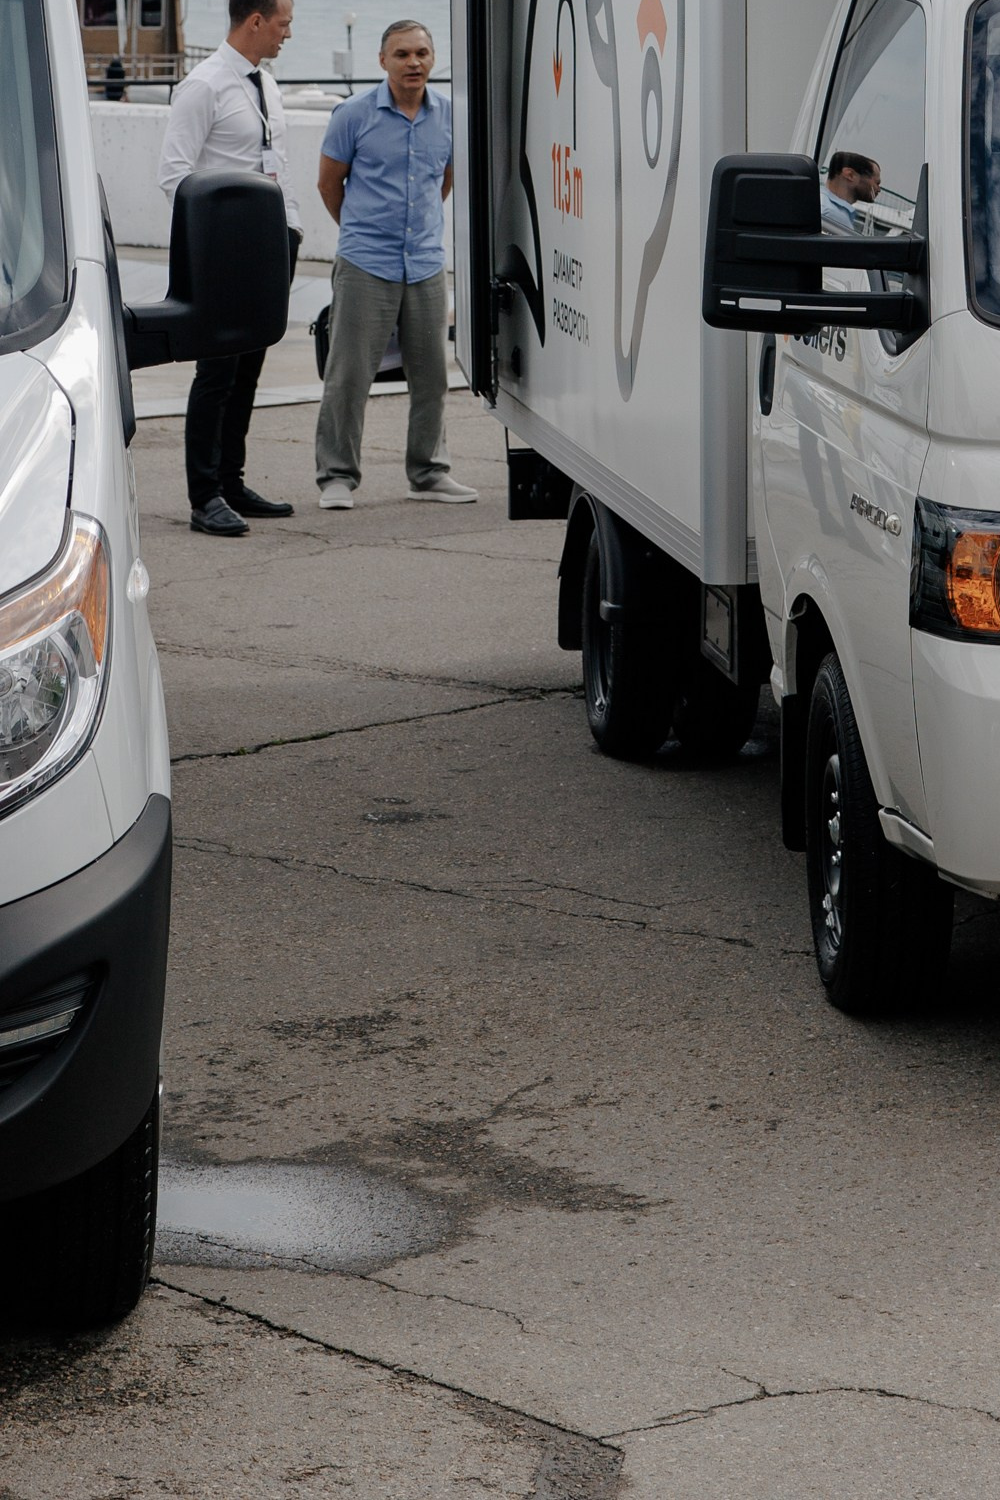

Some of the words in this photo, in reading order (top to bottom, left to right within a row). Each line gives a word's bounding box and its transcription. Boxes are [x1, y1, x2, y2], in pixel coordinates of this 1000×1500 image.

[551, 141, 571, 225] 11,5
[552, 248, 584, 292] ДИАМЕТР
[552, 297, 590, 348] РАЗВОРОТА
